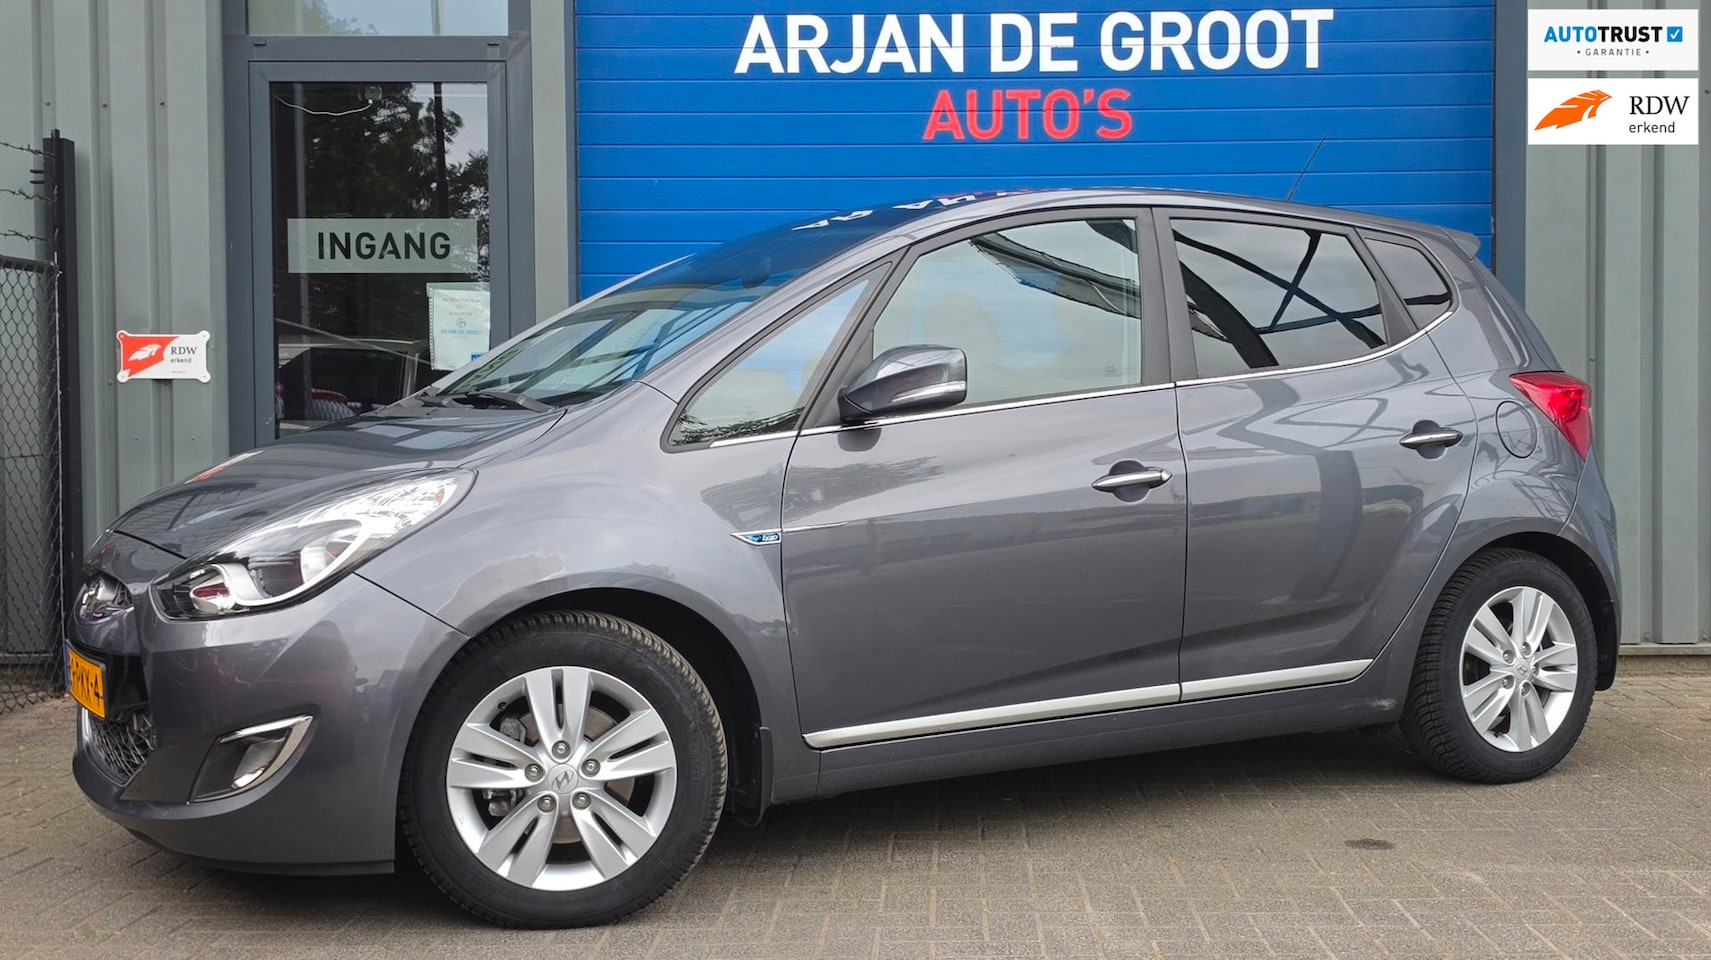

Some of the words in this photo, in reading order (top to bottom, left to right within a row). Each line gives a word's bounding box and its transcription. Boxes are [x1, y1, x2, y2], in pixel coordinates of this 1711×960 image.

[735, 13, 964, 74] ARJAN
[990, 12, 1079, 72] DE
[1100, 9, 1335, 72] GROOT
[922, 88, 1133, 141] AUTO'S
[318, 231, 451, 260] INGANG
[170, 346, 198, 355] RDW
